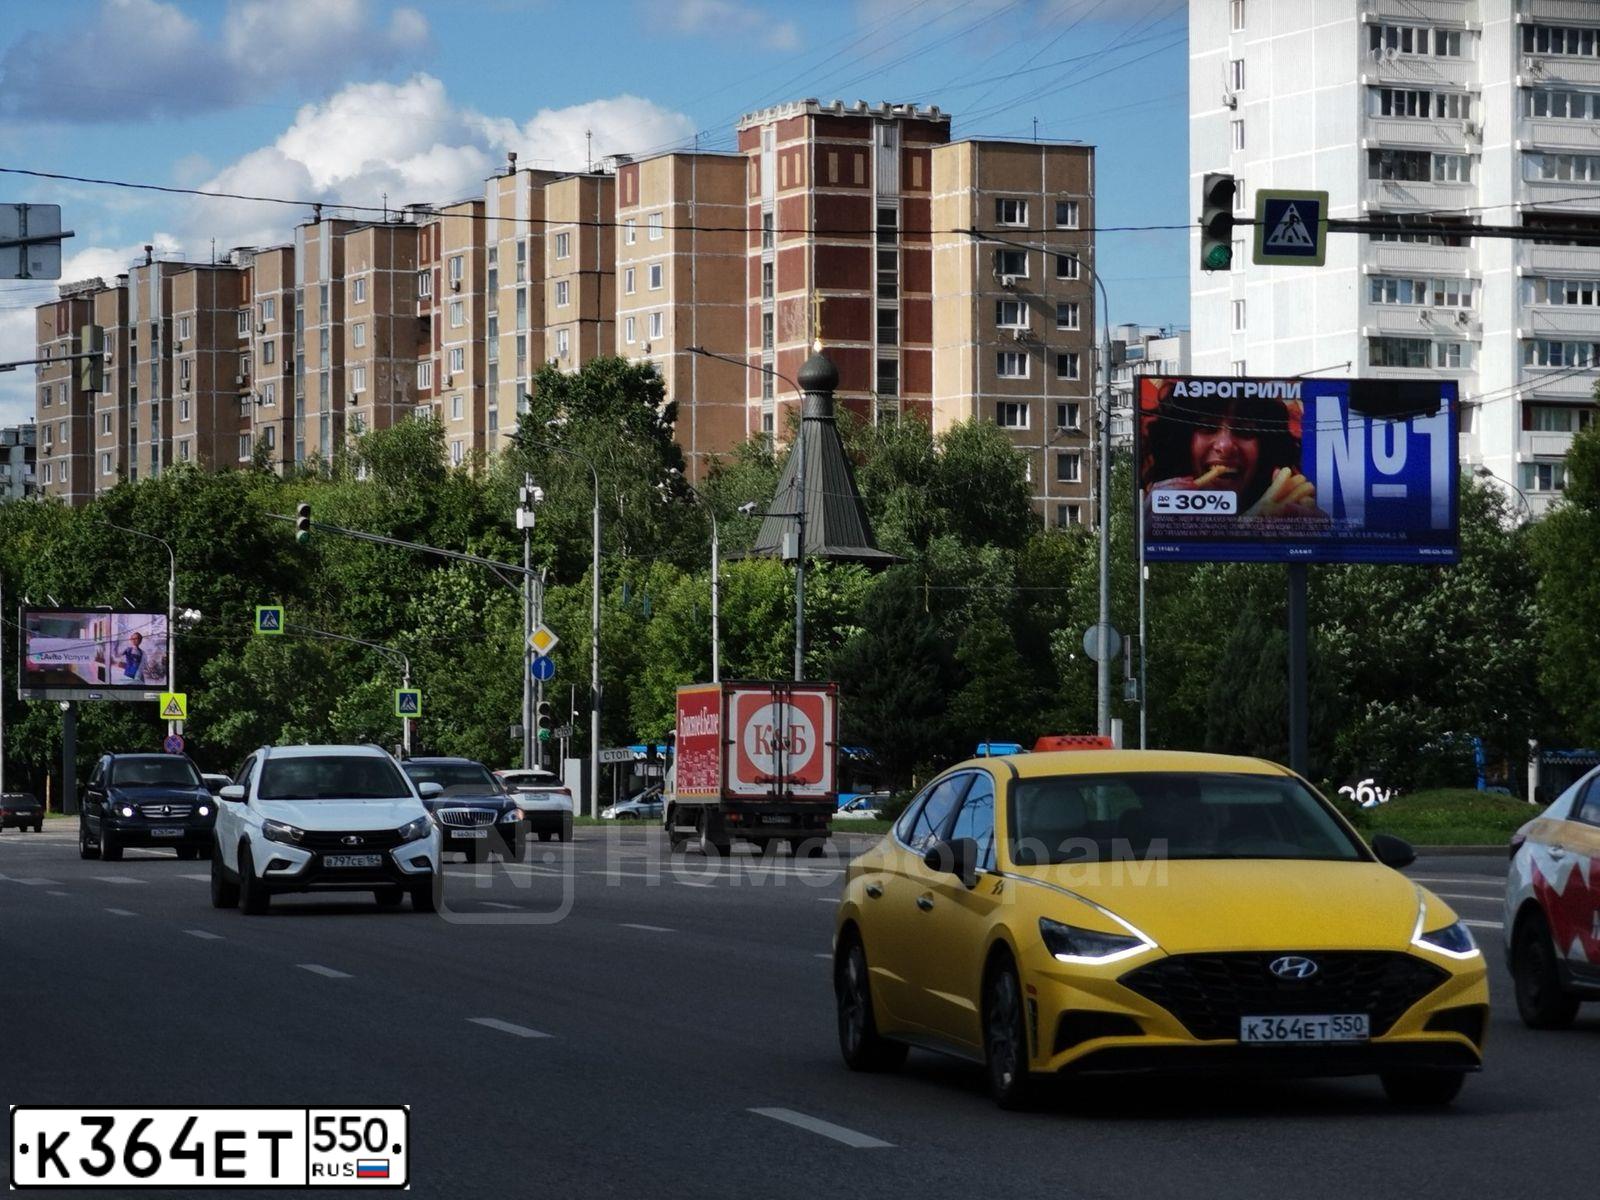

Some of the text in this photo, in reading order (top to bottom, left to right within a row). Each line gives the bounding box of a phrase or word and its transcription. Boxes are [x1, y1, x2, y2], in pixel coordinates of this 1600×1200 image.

[1173, 381, 1302, 398] АЭРОГРИЛИ
[603, 750, 630, 761] СТОП
[1248, 1016, 1363, 1040] К364ЕТ 550
